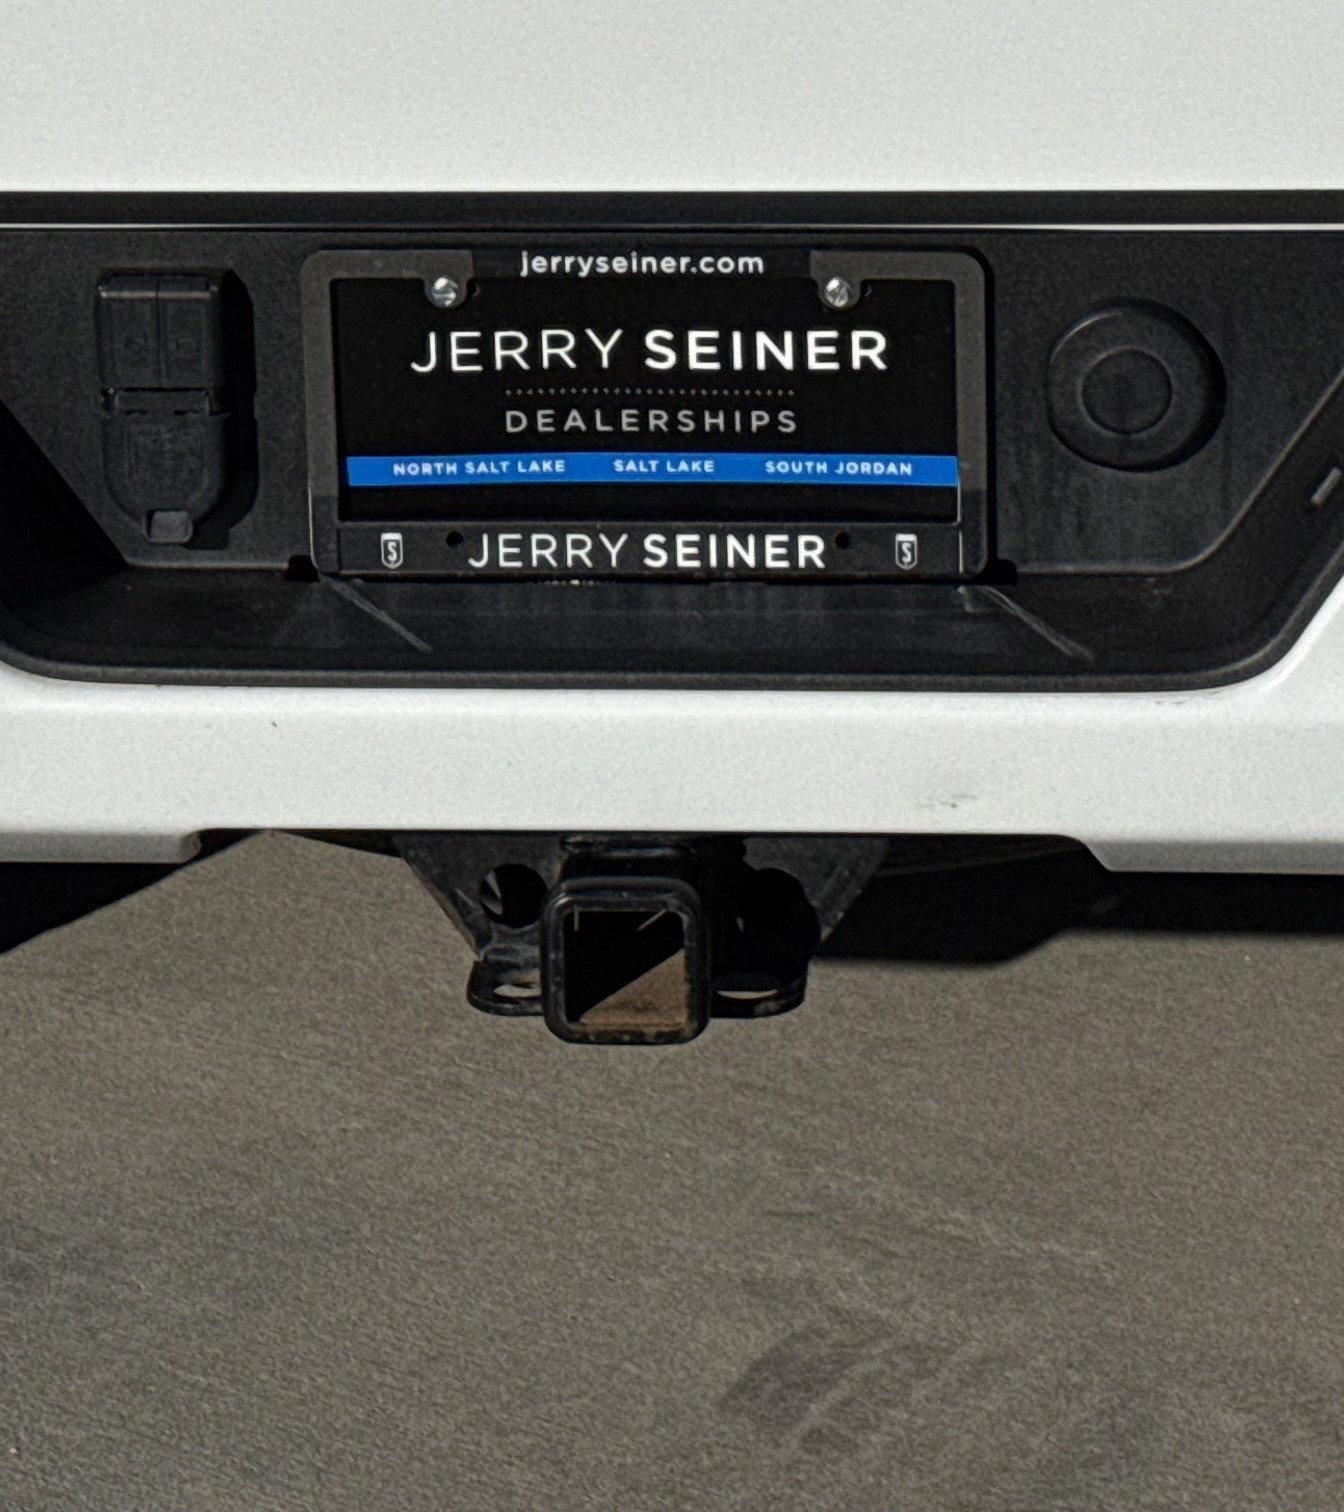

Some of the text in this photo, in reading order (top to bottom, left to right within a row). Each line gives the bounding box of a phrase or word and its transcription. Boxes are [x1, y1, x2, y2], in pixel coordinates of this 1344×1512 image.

[520, 249, 764, 277] jerryseiner.com
[410, 329, 889, 374] JERRY SEINER
[505, 409, 797, 434] DEALERSHIPS
[392, 459, 566, 477] NORTH SALT LAKE
[613, 458, 716, 474] SALT LAKE
[764, 460, 914, 477] SOUTH JORDAN
[468, 533, 826, 569] JERRY SEINER
